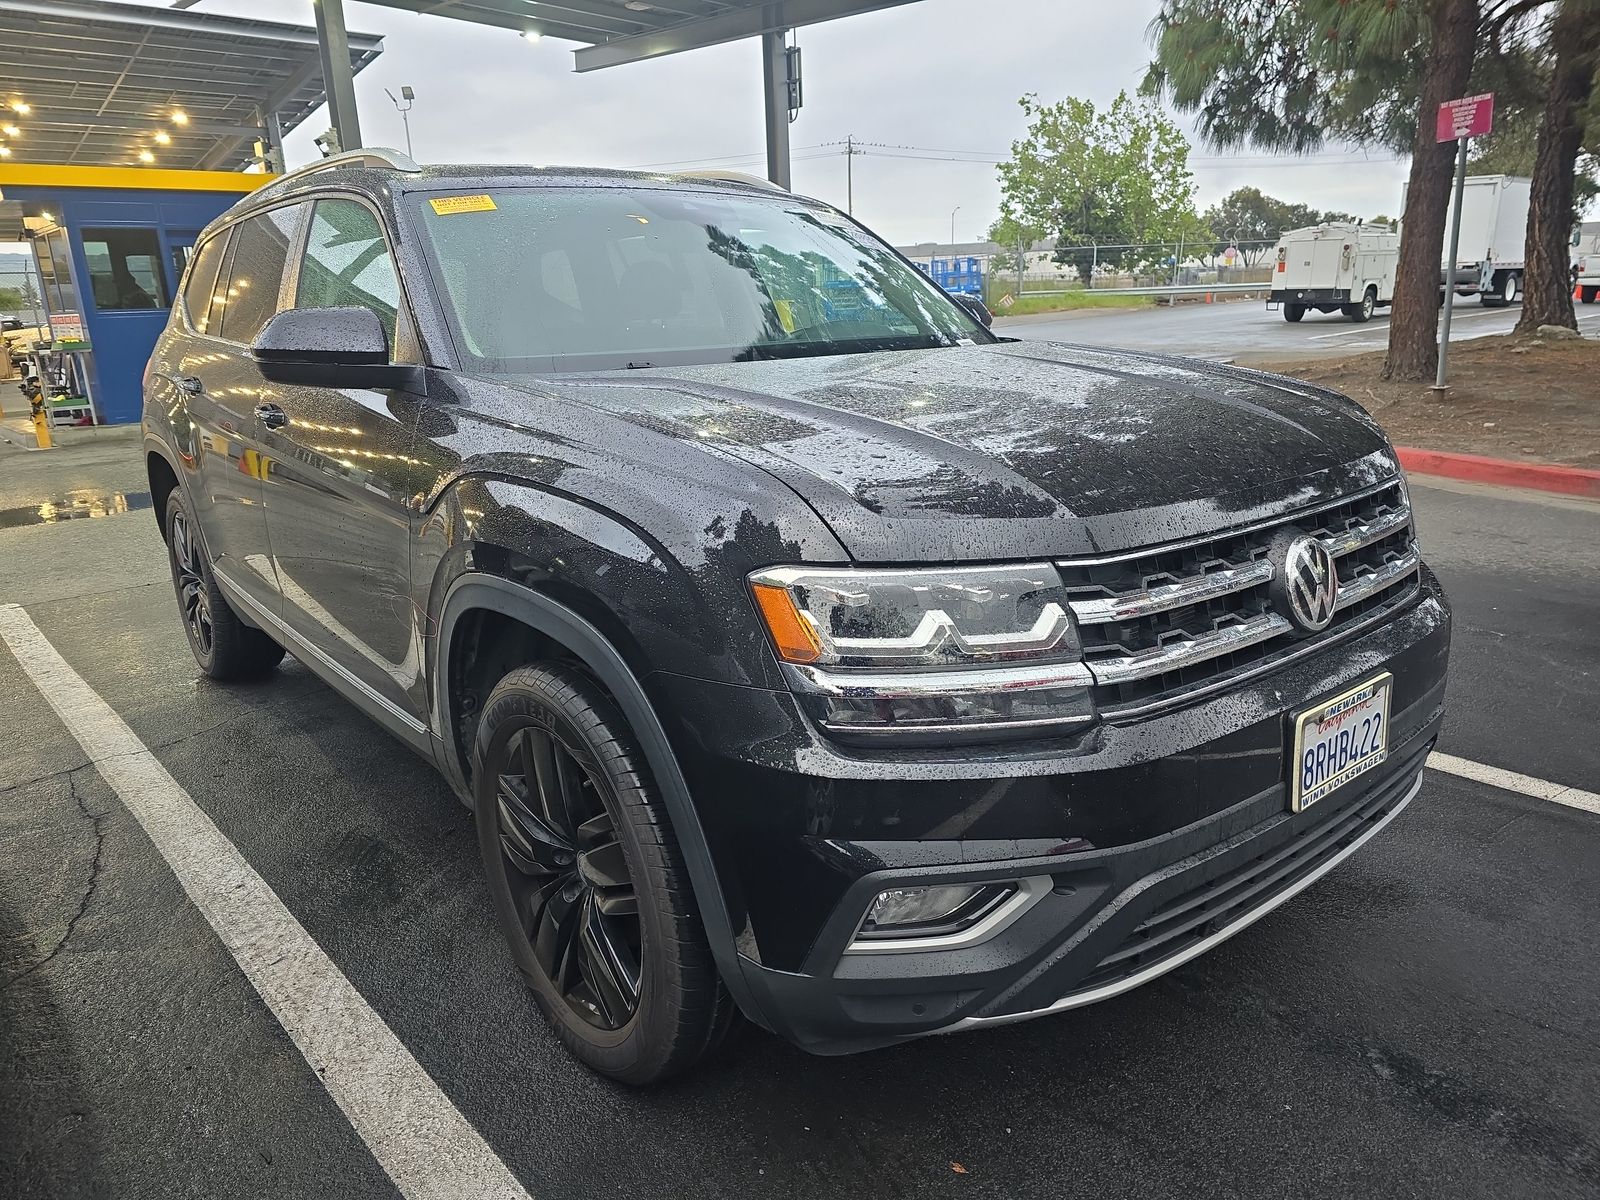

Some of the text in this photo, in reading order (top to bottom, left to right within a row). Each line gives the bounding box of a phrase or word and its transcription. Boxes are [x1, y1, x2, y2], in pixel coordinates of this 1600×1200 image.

[1329, 688, 1369, 716] NEWARK
[1302, 751, 1385, 807] WINN VOLKSWAGEN
[1304, 712, 1382, 790] 8RHB422
